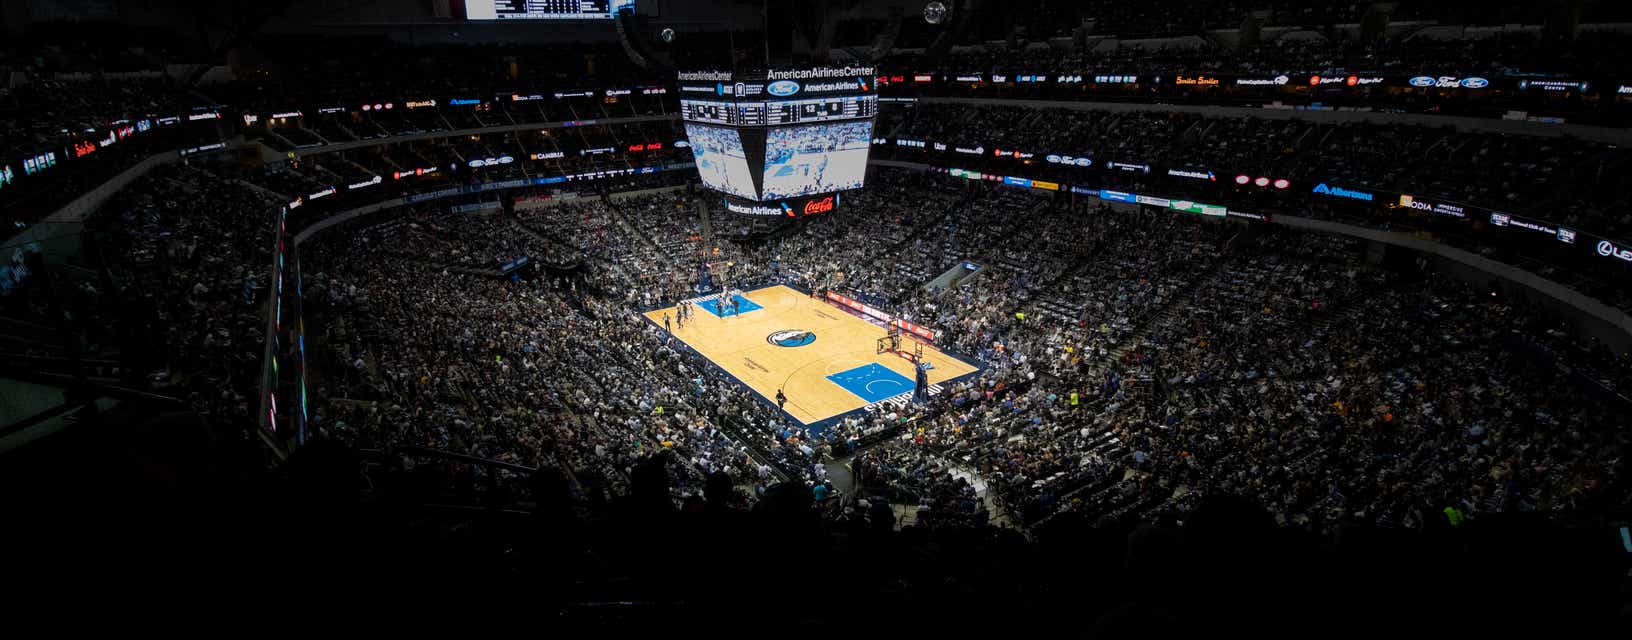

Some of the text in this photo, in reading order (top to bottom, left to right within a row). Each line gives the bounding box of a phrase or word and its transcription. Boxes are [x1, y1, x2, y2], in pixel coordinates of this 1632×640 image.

[993, 75, 1006, 83] Uber
[1435, 76, 1461, 87] Ford
[804, 83, 834, 92] American
[1331, 186, 1373, 201] Albertsons
[752, 206, 782, 216] Airlines
